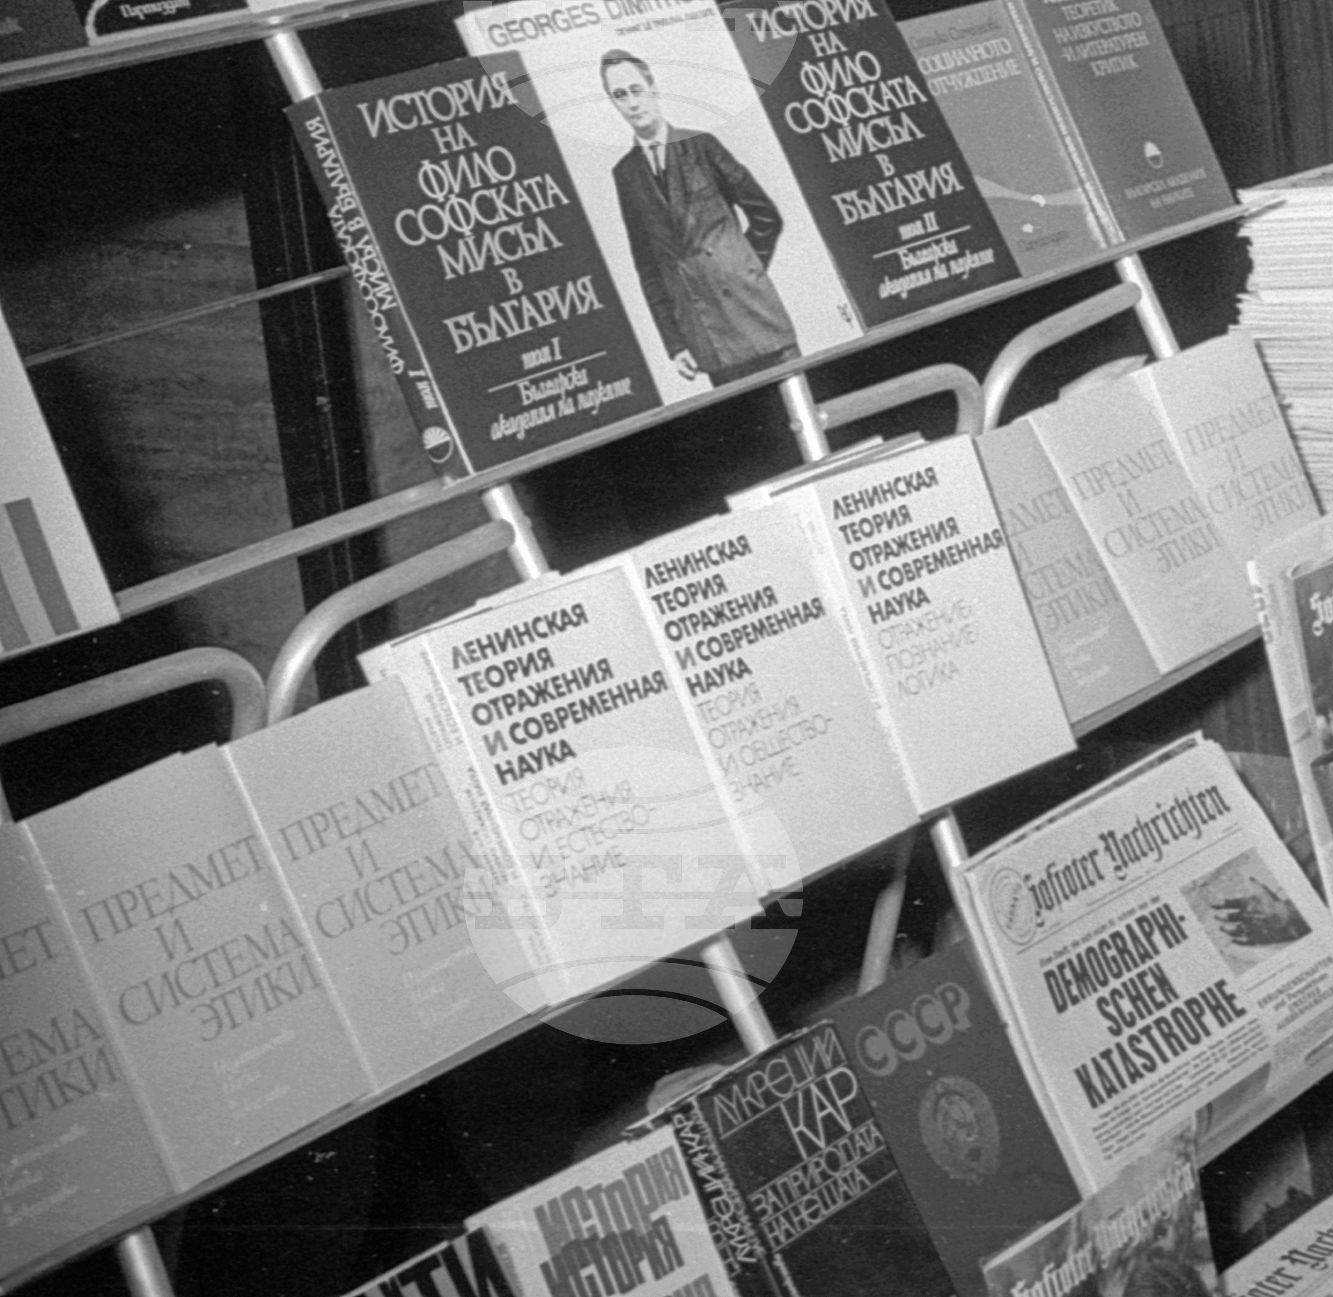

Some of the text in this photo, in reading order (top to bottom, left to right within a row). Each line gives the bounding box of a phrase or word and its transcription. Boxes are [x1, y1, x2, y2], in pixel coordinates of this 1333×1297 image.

[487, 2, 601, 48] GEORGES
[808, 32, 849, 59] НА
[917, 36, 1014, 76] СОЦИАЛНОТО
[357, 70, 518, 138] ИСТОРИЯ
[784, 74, 929, 135] СОФСКАТА
[799, 49, 882, 98] ФИЛО
[926, 60, 1023, 98] ОТЧУЖДЕНИЕ
[304, 115, 362, 215] БЪЛГАРИЯ
[432, 122, 478, 155] НА
[821, 111, 926, 164] МИСЪЛ
[877, 153, 895, 178] В
[418, 145, 517, 203] ФИЛО
[831, 160, 966, 227] БЪЛГАРИЯ
[395, 173, 570, 247] СОФСКАТА
[437, 216, 564, 281] МИСЪЛ
[443, 274, 604, 355] БЪЛГАРИЯ
[502, 268, 524, 296] В
[832, 467, 940, 520] ЛЕНИНСКАЯ
[838, 504, 914, 547] ТЕОРИЯ
[643, 534, 753, 590] ЛЕНИНСКАЯ
[848, 515, 962, 574] ОТРАЖЕНИЯ
[859, 528, 1005, 599] И СОВРЕМЕННАЯ
[650, 573, 728, 617] ТЕОРИЯ
[663, 585, 779, 643] ОТРАЖЕНИЯ
[867, 586, 932, 626] НАУКА
[451, 602, 589, 671] ЛЕНИНСКАЯ
[675, 597, 828, 670] И СОВРЕМЕННАЯ
[457, 646, 555, 700] ТЕОРИЯ
[470, 657, 614, 728] ОТРАЖЕНИЯ
[683, 656, 753, 699] НАУКА
[483, 669, 669, 758] И СОВРЕМЕННАЯ
[494, 737, 577, 788] НАУКА
[277, 759, 447, 864] ПРЕДМЕТ
[1100, 782, 1232, 881] Nachrichten
[79, 831, 271, 944] ПРЕДМЕТ
[313, 841, 479, 942] СИСТЕМА
[343, 839, 384, 880] И
[153, 915, 201, 962] И
[385, 881, 496, 957] ЭТИКИ
[116, 918, 309, 1028] СИСТЕМА
[1042, 901, 1188, 1015] DEMOGRAPHI-
[199, 952, 325, 1043] ЭТИКИ
[855, 981, 972, 1077] СССР
[1095, 962, 1180, 1037] SCHEN
[1072, 977, 1248, 1110] KATASTROPHE
[0, 1046, 121, 1132] ТИКИ
[781, 1066, 859, 1159] КАР
[533, 1141, 691, 1253] ИСТОРИЯ
